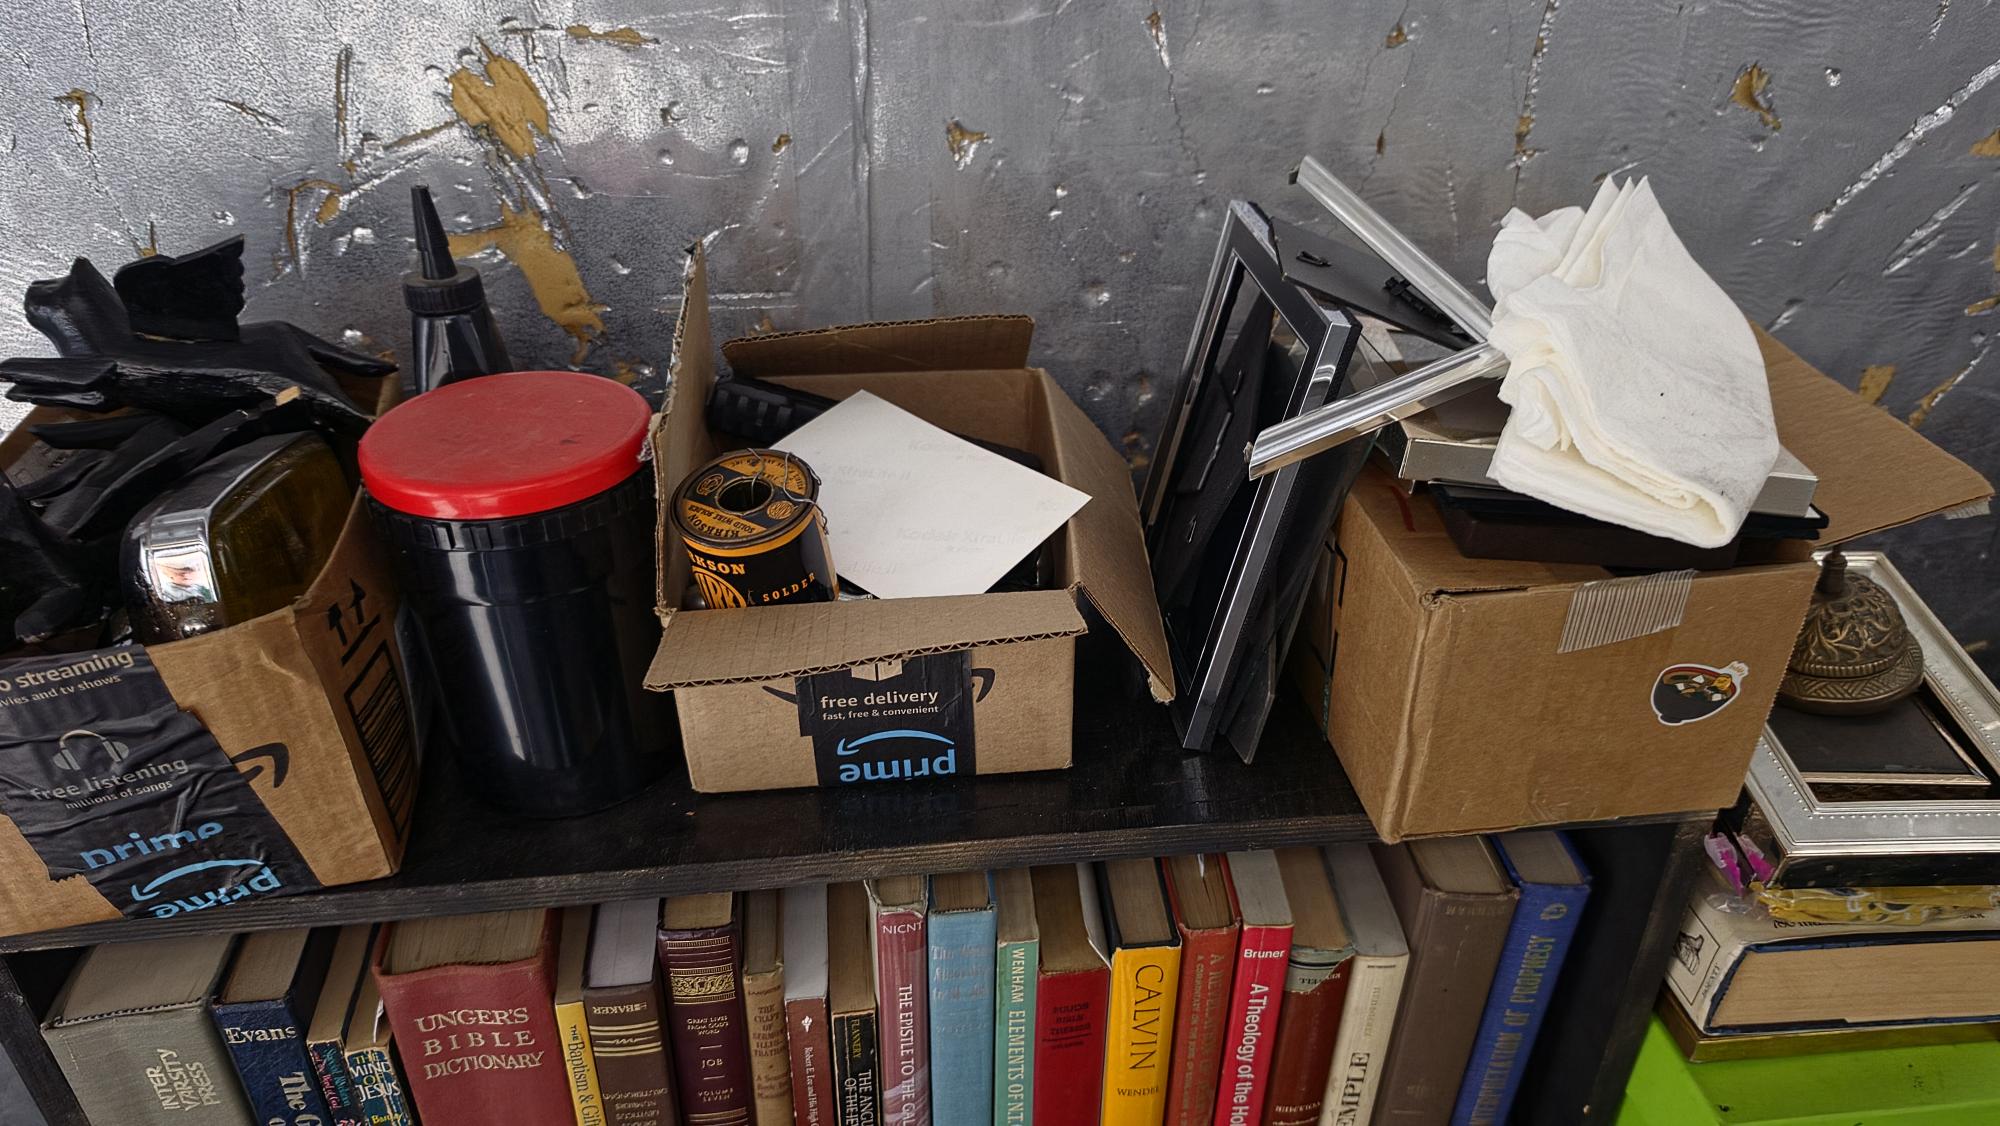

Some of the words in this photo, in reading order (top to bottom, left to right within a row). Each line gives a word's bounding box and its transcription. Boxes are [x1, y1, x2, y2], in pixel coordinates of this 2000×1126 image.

[688, 514, 741, 538] KIRKSON
[763, 572, 816, 602] SOLDER
[15, 652, 135, 688] streaming
[32, 688, 59, 701] and
[60, 684, 75, 695] tv
[78, 674, 121, 691] shows
[820, 694, 858, 709] free
[863, 689, 939, 709] delivery
[822, 711, 845, 721] fast,
[848, 709, 870, 719] free
[872, 709, 880, 717] &
[883, 705, 939, 715] convenient
[839, 749, 956, 782] prime
[31, 777, 82, 801] free
[86, 758, 190, 793] listening
[65, 789, 118, 810] millions
[120, 787, 135, 798] of
[135, 779, 174, 796] songs
[883, 921, 922, 935] NICNT
[1210, 954, 1224, 965] A
[1243, 949, 1285, 958] Bruner
[1011, 947, 1025, 1003] WENHAM
[1510, 934, 1556, 1003] PROPHECY
[899, 984, 913, 1010] THE
[1251, 983, 1269, 995] A
[415, 1007, 530, 1033] UNGER'S
[592, 1004, 633, 1014] BAKER
[1129, 964, 1164, 1069] CALVIN
[1503, 1009, 1530, 1026] OF
[224, 1026, 298, 1044] Evans
[570, 1024, 581, 1041] THE
[762, 1022, 773, 1031] OF
[850, 1018, 862, 1059] FLANNERY
[899, 1011, 914, 1056] EPISTLE
[1236, 995, 1269, 1066] Theology
[424, 1031, 536, 1056] BIBLE
[1008, 1010, 1026, 1079] ELEMENTS
[424, 1051, 545, 1080] DICTIONARY
[566, 1040, 591, 1092] Baptism
[702, 1059, 723, 1068] JOB
[804, 1046, 814, 1066] Robert
[901, 1057, 915, 1076] TO
[157, 1049, 200, 1111] VARSITY
[349, 1061, 391, 1078] MIND
[363, 1072, 385, 1086] OF
[806, 1075, 815, 1085] Lee
[858, 1069, 873, 1094] THE
[1237, 1066, 1254, 1081] of
[145, 1065, 181, 1110] INTER
[185, 1062, 221, 1106] PRESS
[278, 1071, 312, 1110] The
[355, 1078, 400, 1102] JESUS
[698, 1088, 733, 1096] VOLUME
[844, 1078, 857, 1093] OF
[901, 1077, 916, 1101] THE
[1008, 1084, 1024, 1101] OF
[1232, 1080, 1253, 1103] the
[578, 1093, 595, 1104] &
[845, 1093, 858, 1112] THE
[1007, 1102, 1024, 1124] N.T.
